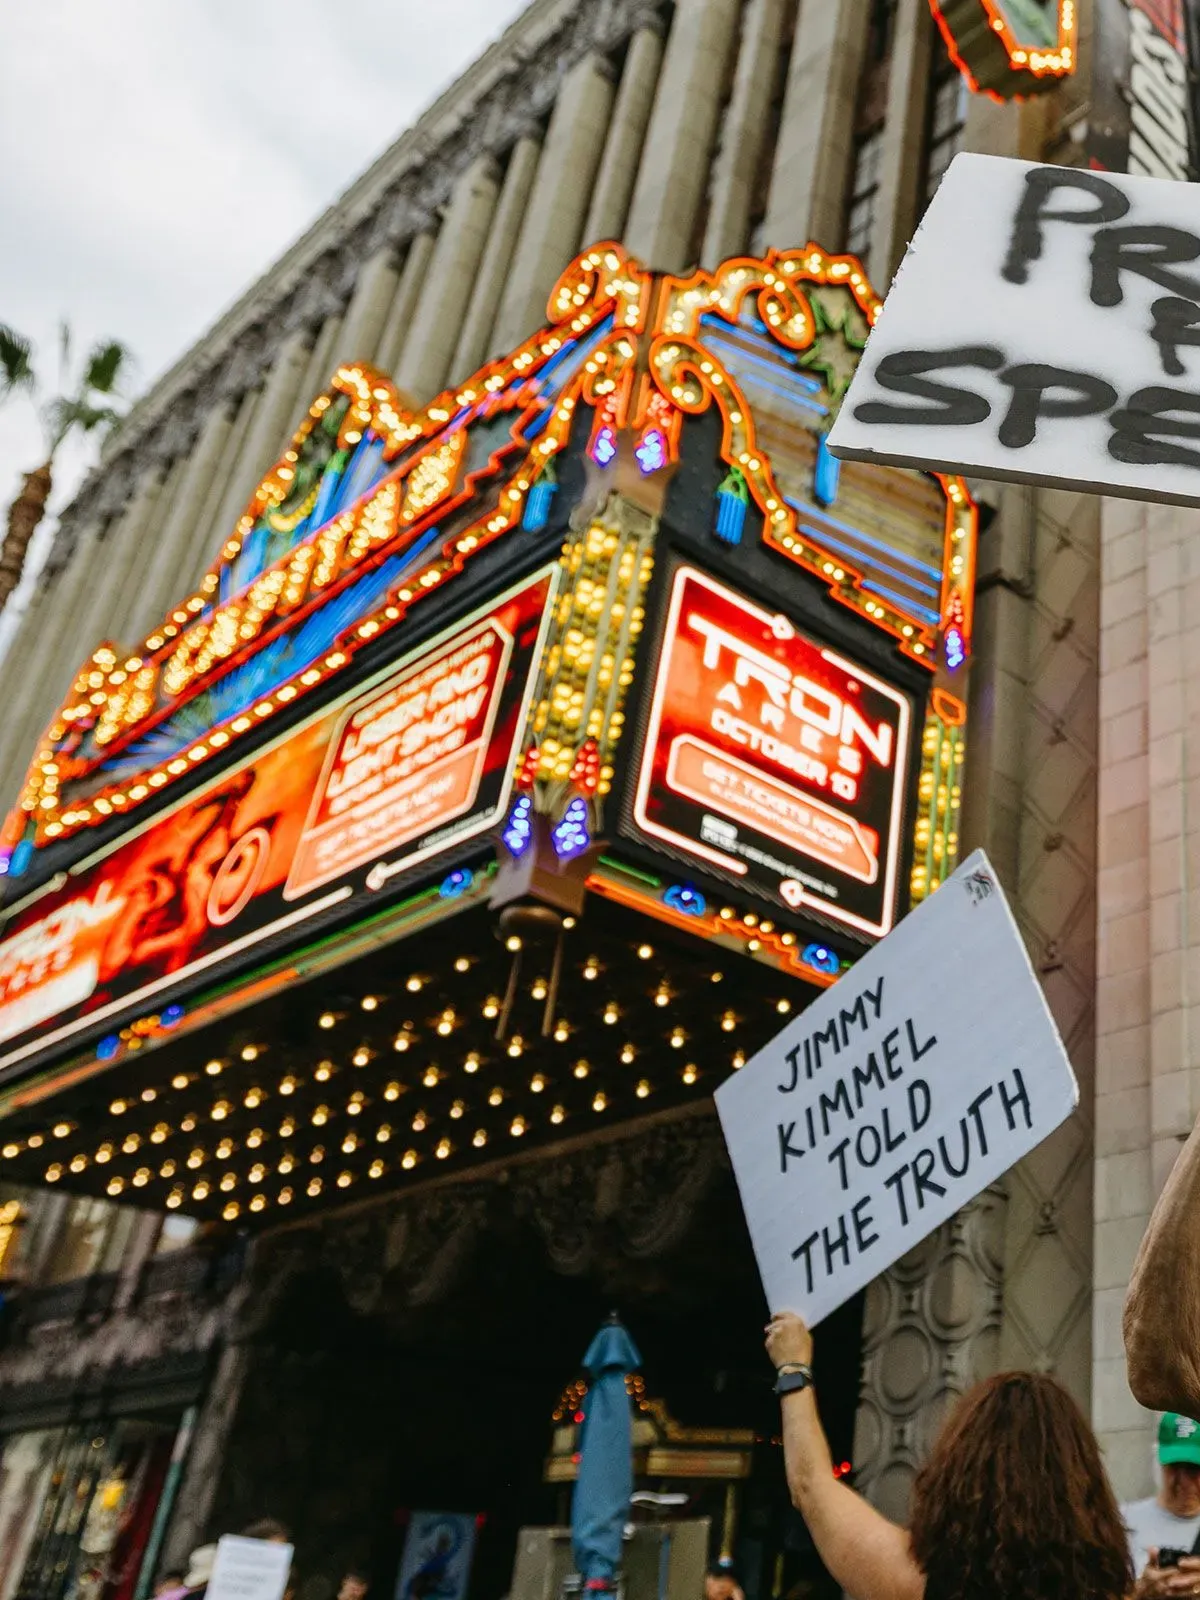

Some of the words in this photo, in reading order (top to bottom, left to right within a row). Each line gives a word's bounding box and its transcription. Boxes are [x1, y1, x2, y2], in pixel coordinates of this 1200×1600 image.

[687, 612, 893, 768] TRON
[716, 681, 862, 775] ARES
[711, 707, 828, 787] OCTOBER
[830, 770, 857, 801] 10
[777, 976, 885, 1094] JIMMY
[778, 1018, 938, 1174] KIMMEL
[828, 1079, 931, 1190] TOLD
[791, 1196, 880, 1294] THE
[884, 1068, 1033, 1226] TRUTH
